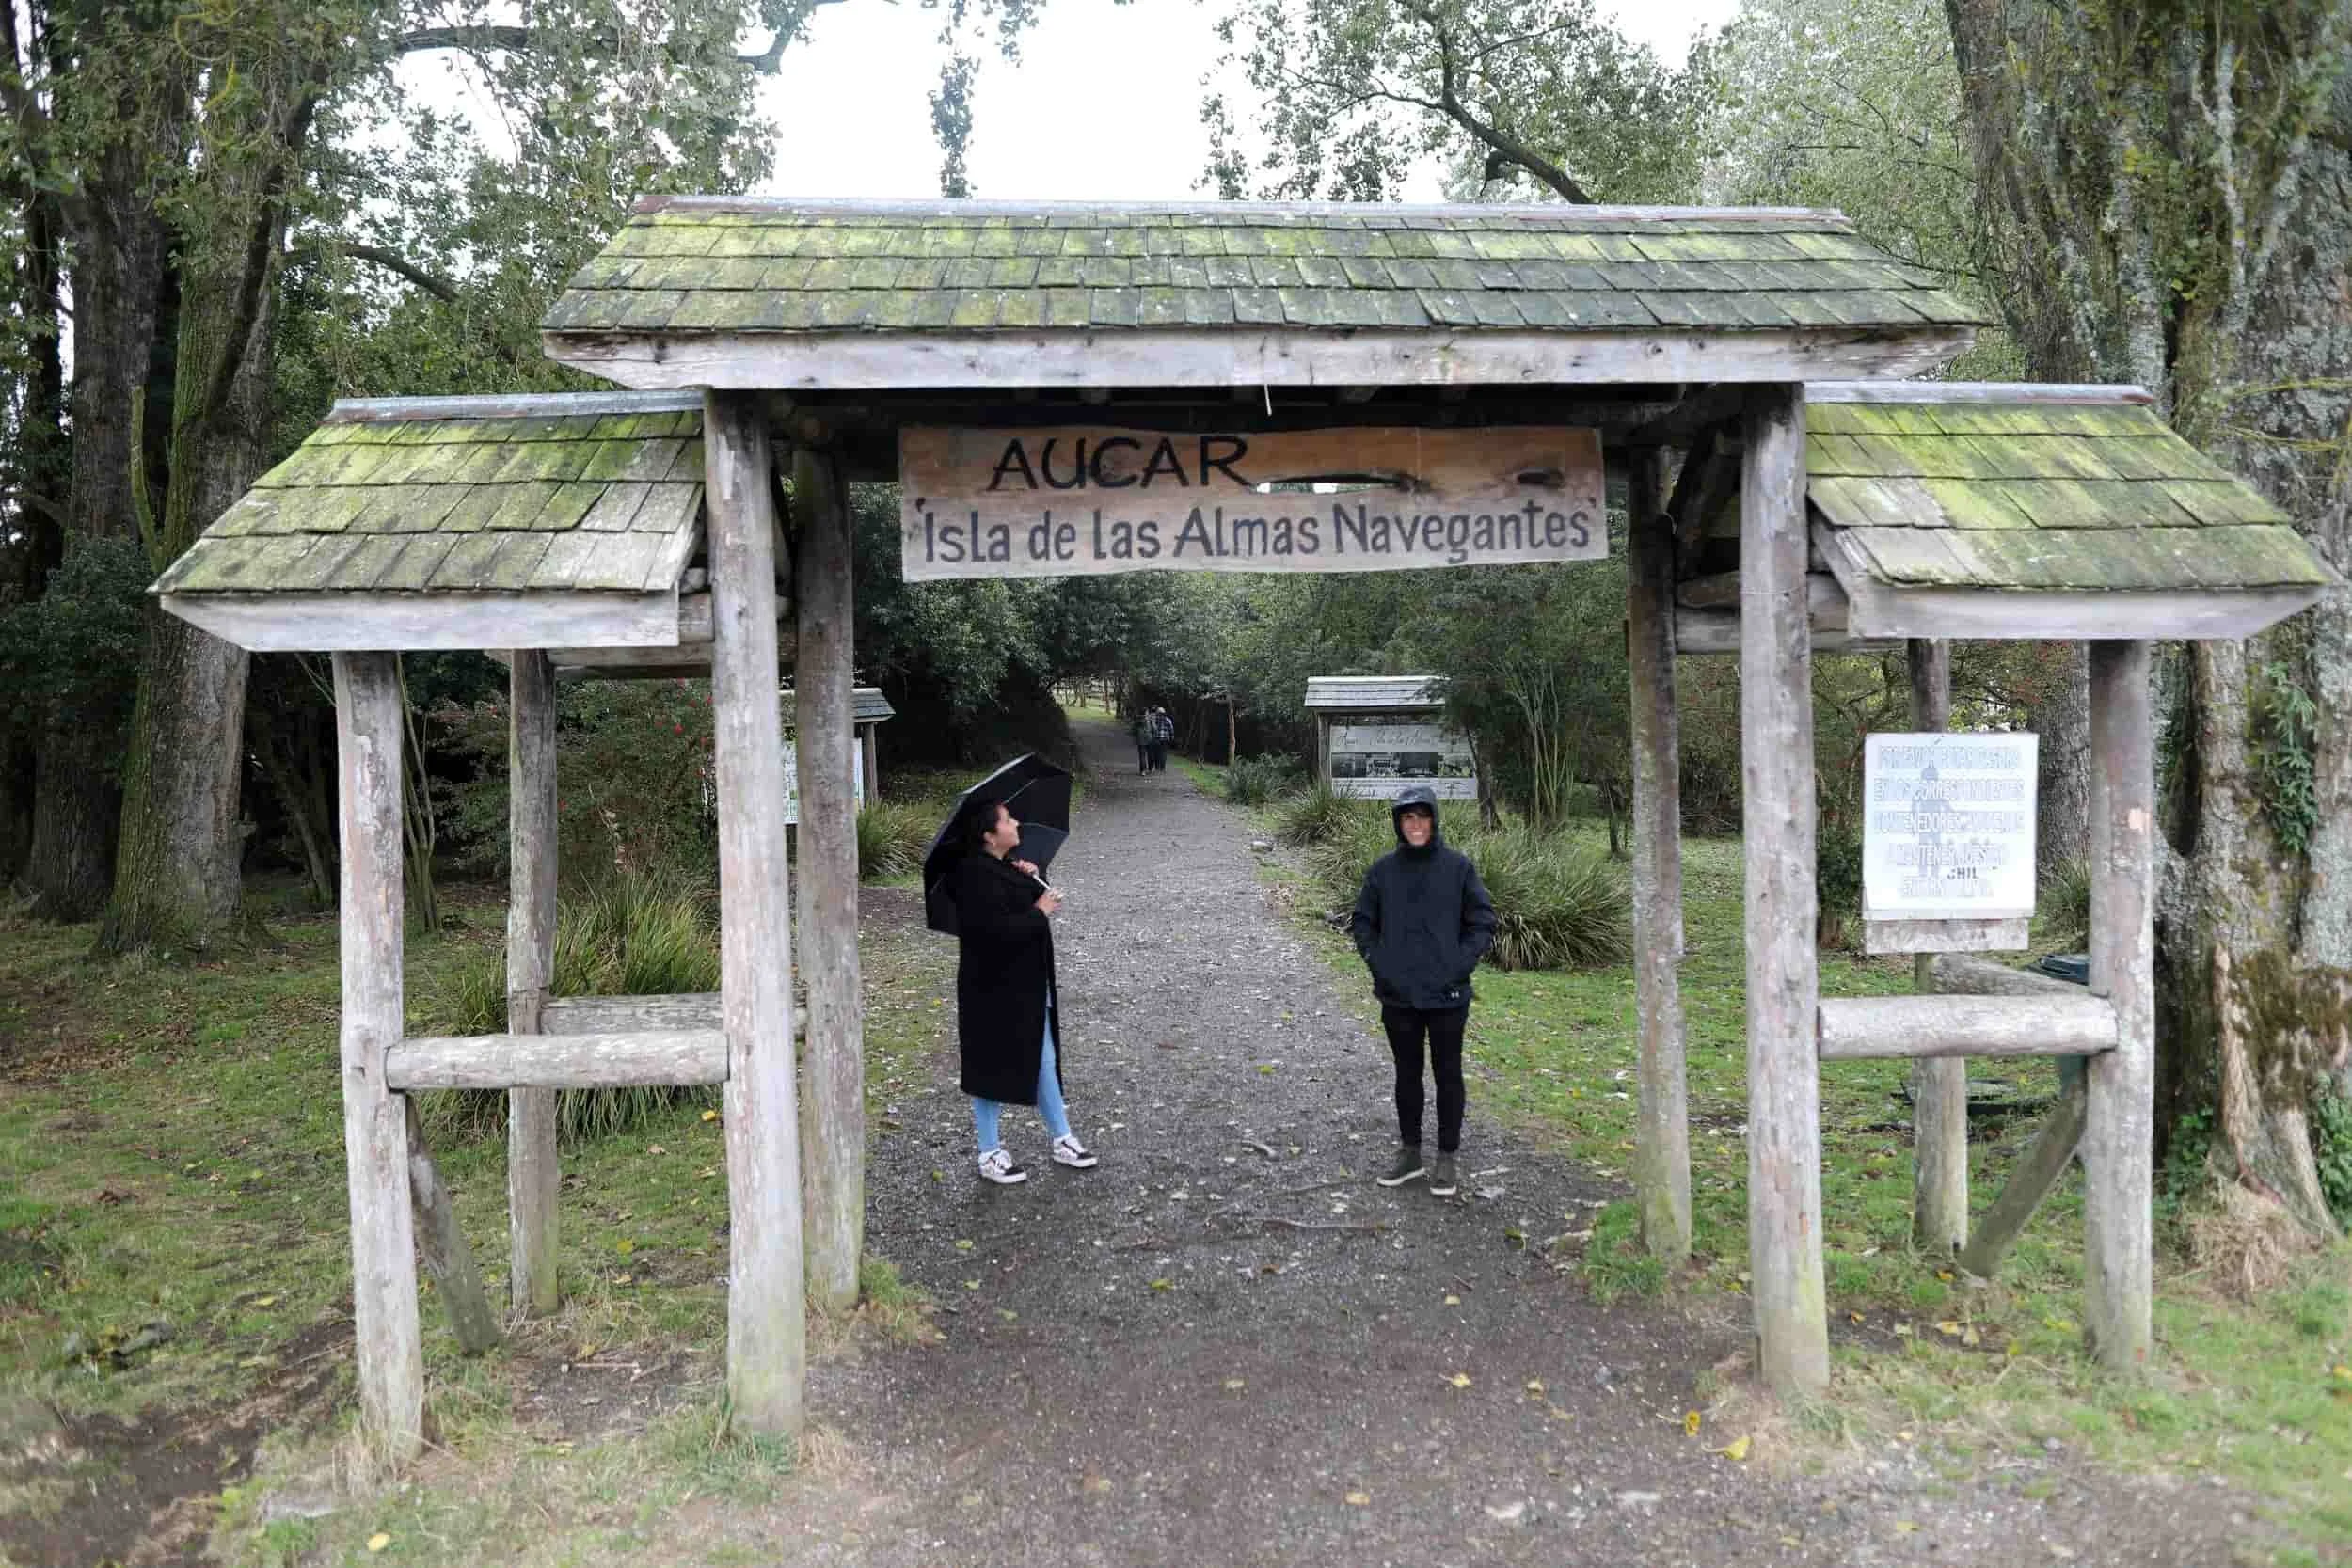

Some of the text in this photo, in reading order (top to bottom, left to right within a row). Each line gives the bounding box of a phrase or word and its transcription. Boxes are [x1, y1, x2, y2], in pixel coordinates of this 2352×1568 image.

[988, 435, 1251, 488] AUCAR
[1027, 509, 1077, 559] de
[1173, 507, 1322, 557] Almas
